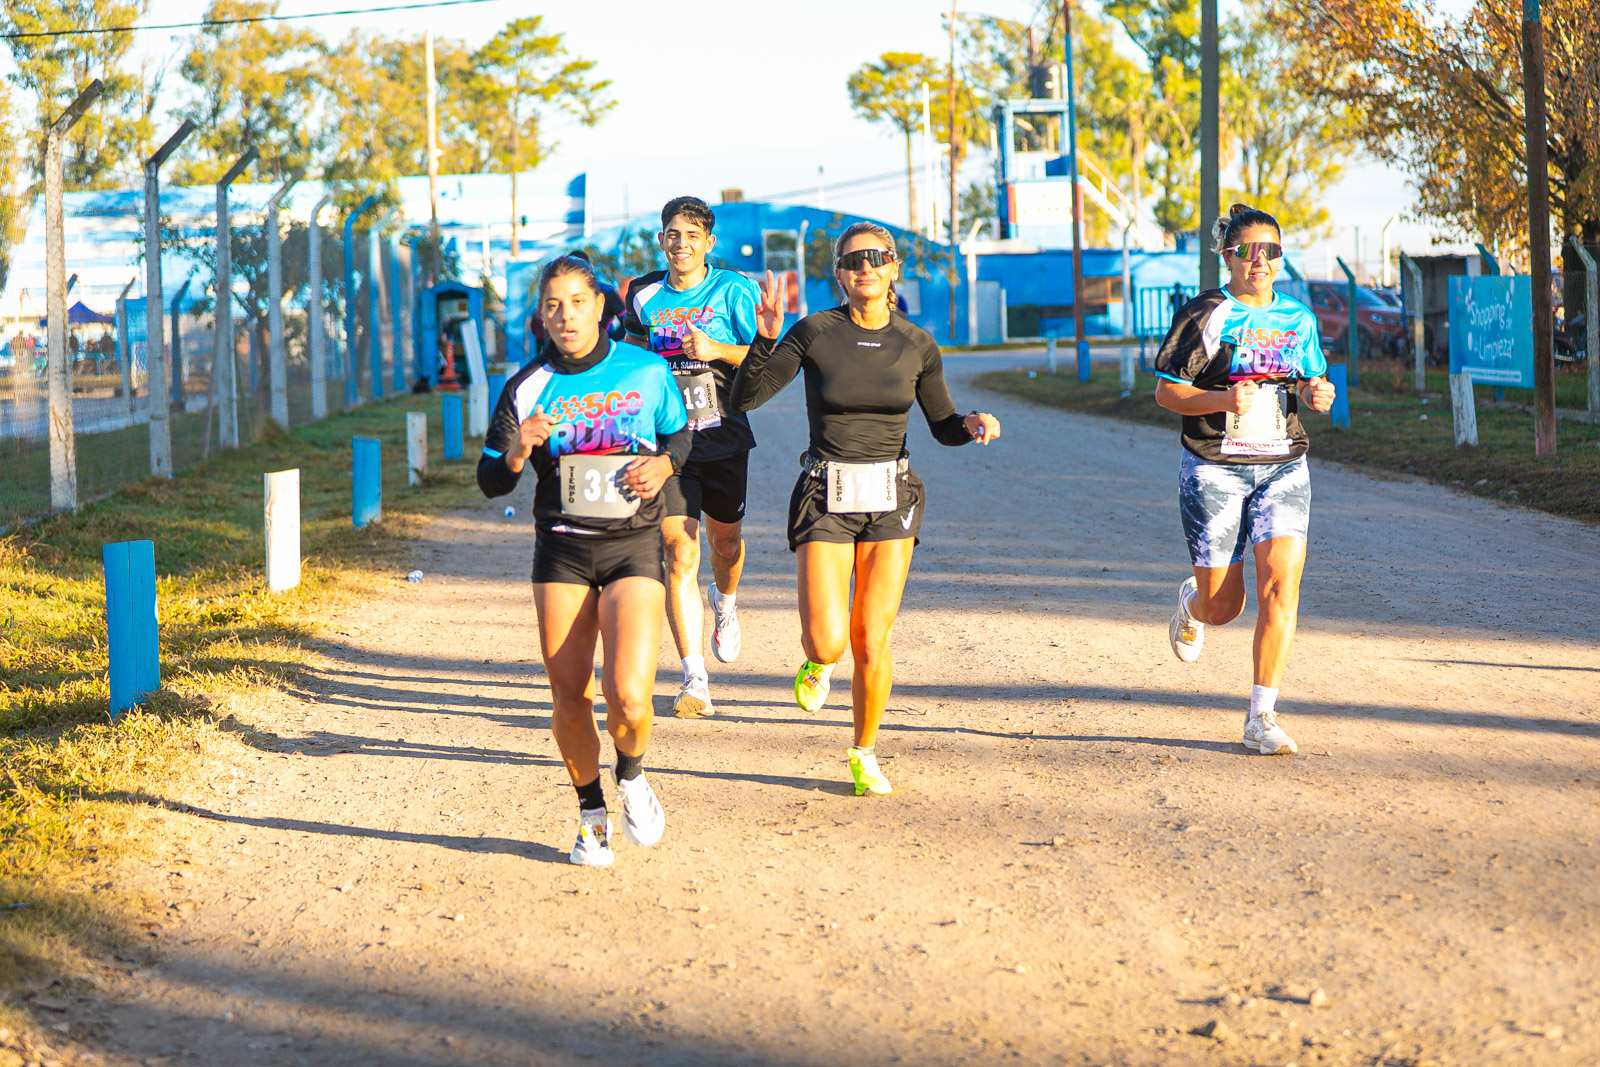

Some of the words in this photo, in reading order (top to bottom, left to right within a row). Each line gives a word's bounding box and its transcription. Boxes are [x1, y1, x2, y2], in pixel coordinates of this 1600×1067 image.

[671, 307, 715, 326] 500
[1470, 301, 1505, 330] Shopping
[1257, 328, 1297, 349] 500
[1479, 337, 1512, 366] Limpieza
[1230, 346, 1295, 375] RUN
[583, 391, 642, 419] 500
[549, 418, 632, 458] RUN
[568, 466, 576, 504] TIEMPO
[584, 468, 618, 503] 31
